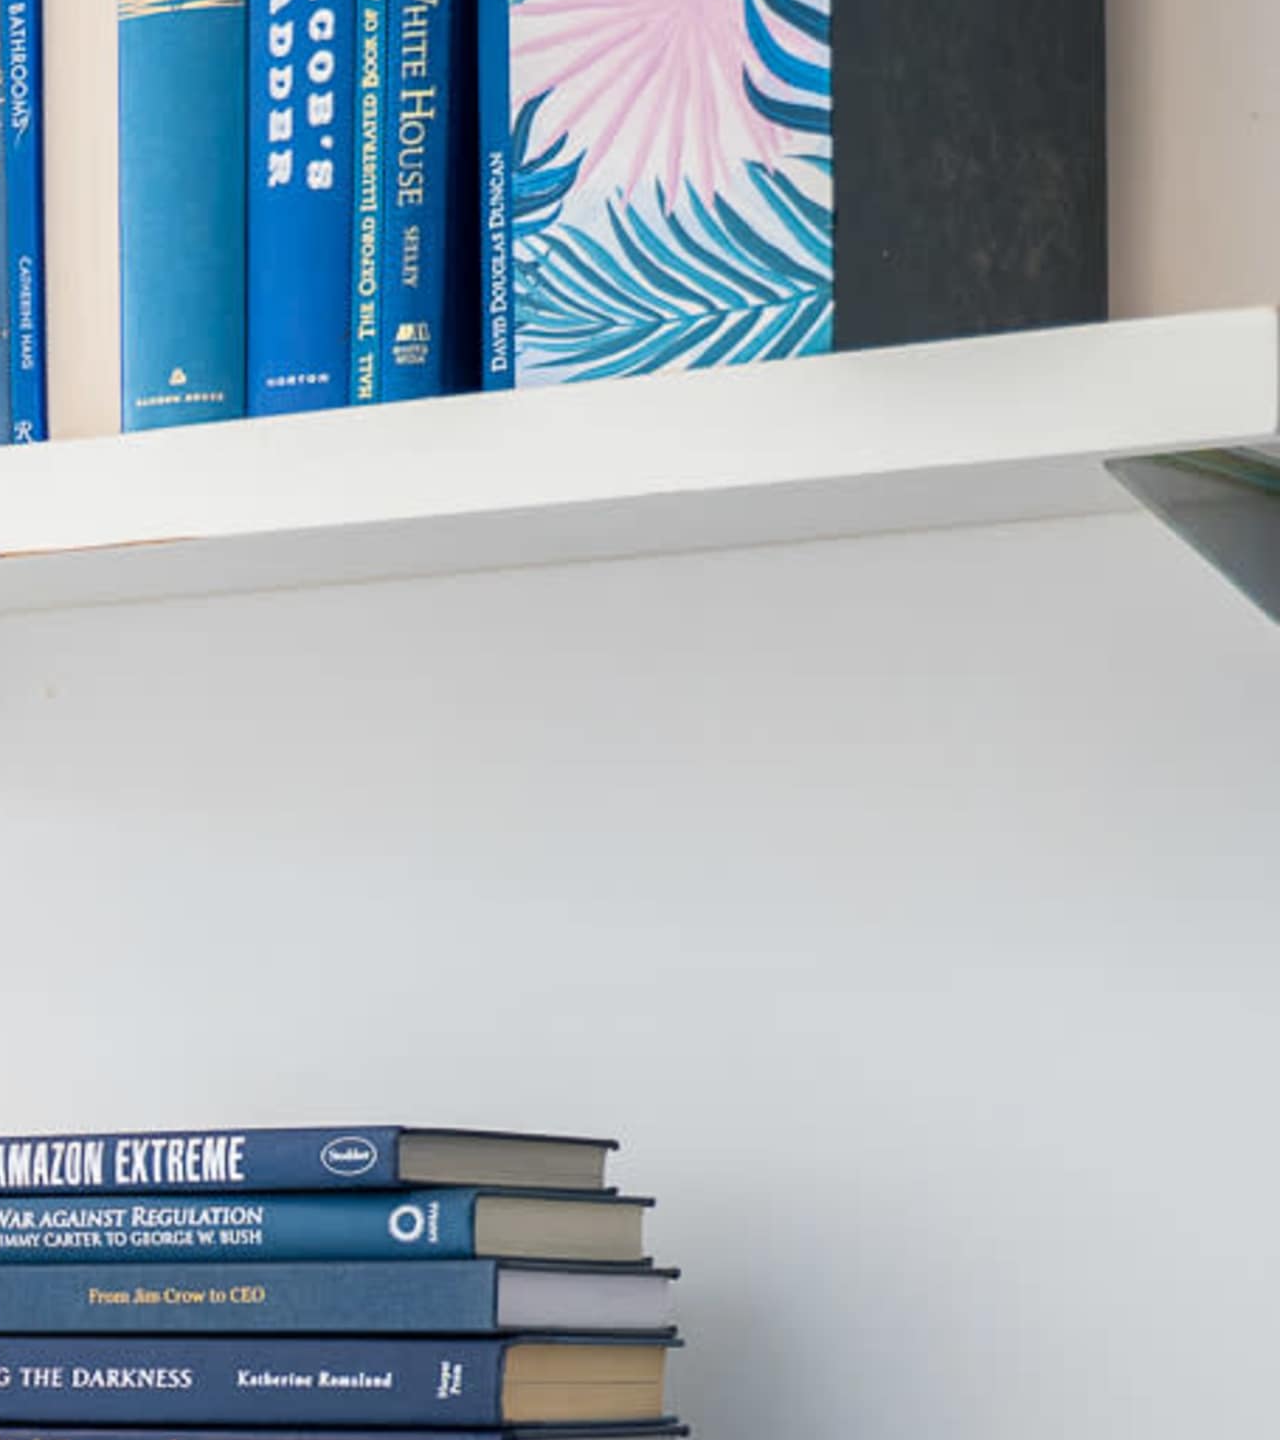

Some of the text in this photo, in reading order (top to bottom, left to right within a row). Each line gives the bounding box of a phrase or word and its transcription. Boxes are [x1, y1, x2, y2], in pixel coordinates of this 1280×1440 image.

[364, 9, 379, 33] OF
[8, 1, 32, 135] BATHROOMS
[361, 35, 380, 89] BOOK
[359, 93, 380, 213] ILLUSTRATED
[396, 85, 437, 208] HOUSE
[358, 216, 378, 297] OXFORD
[488, 150, 510, 373] DAVID DOUGLAS DUNCAN
[18, 255, 35, 330] CATHERINE
[357, 300, 377, 342] THE
[21, 334, 36, 371] HAIG
[266, 372, 330, 388] NORTON
[357, 352, 374, 400] HALL
[113, 1136, 246, 1185] EXTREME
[41, 1208, 124, 1228] AGAINST
[130, 1205, 265, 1228] REGULATION
[42, 1230, 103, 1248] CARTER
[105, 1230, 126, 1248] TO
[129, 1229, 195, 1247] GEORGE
[197, 1228, 218, 1246] W.
[219, 1228, 263, 1245] BUSH
[88, 1286, 267, 1305] From Jim Crow to CEO
[19, 1367, 64, 1388] THE
[71, 1367, 195, 1390] DARKNESS
[236, 1368, 313, 1389] Katherine
